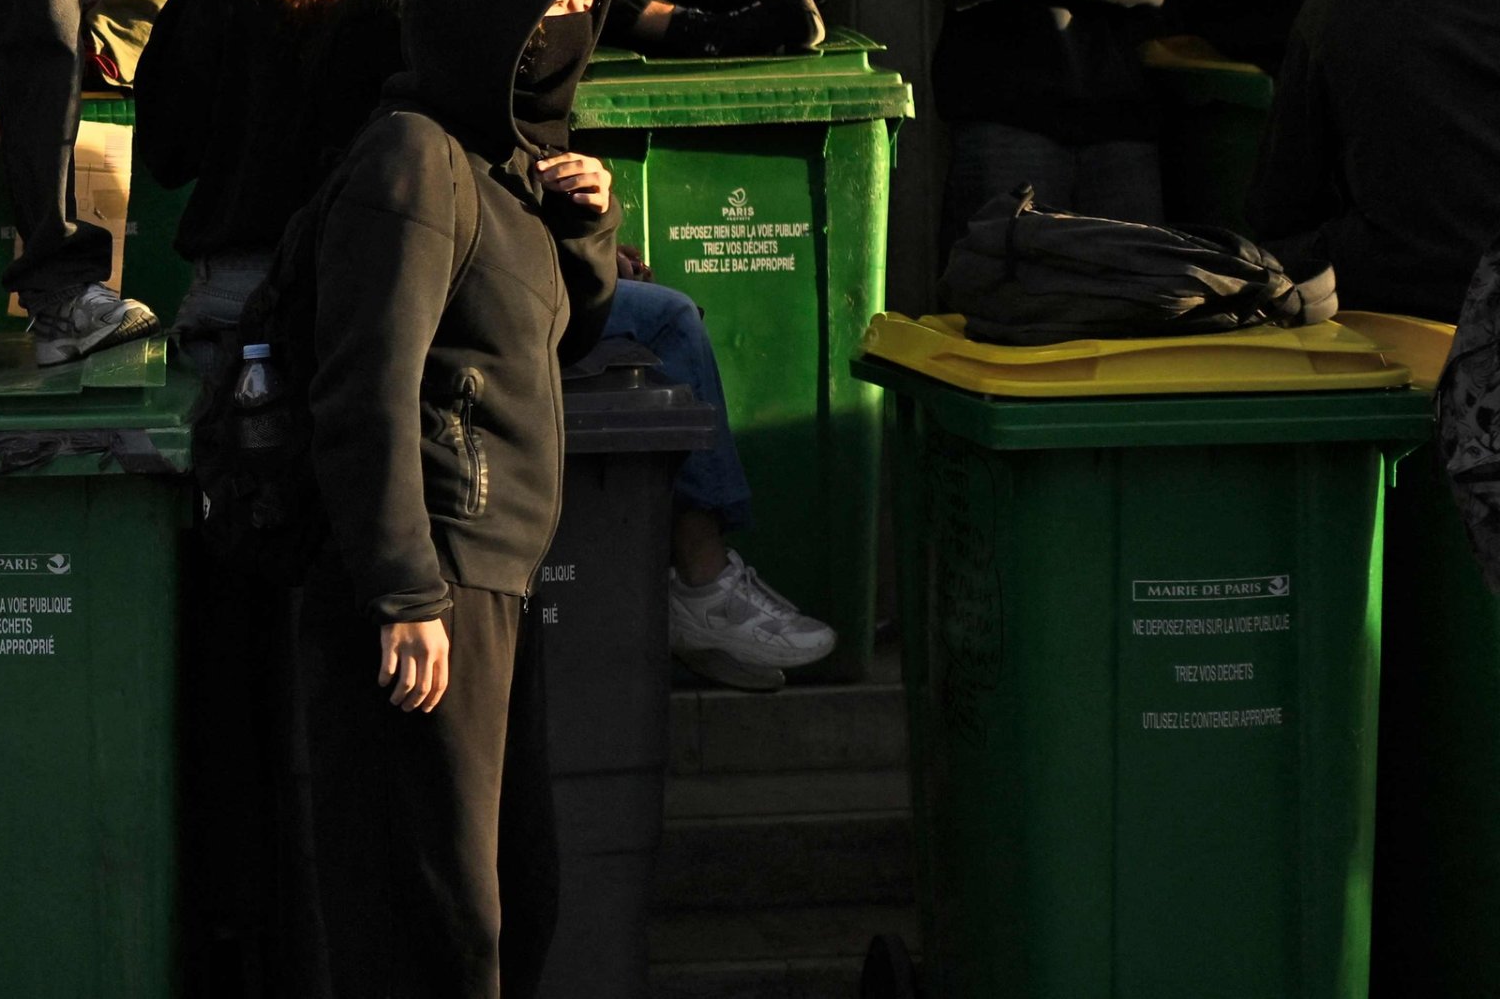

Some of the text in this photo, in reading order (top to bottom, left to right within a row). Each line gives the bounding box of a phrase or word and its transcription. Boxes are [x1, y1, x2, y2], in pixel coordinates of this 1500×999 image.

[721, 206, 755, 217] PARIS
[669, 222, 810, 241] NE DÉPOSEZ RIEN SUR LA VOIE PUBLIQUE
[703, 237, 778, 256] TRIEZ VOS DÉCHETS
[684, 254, 795, 274] UTILISEZ LE BAC APPROPRIÉ
[1147, 582, 1262, 597] MAIRIE DE PARIS
[7, 597, 28, 613] VOIE
[29, 597, 73, 613] PUBLIQUE
[1132, 613, 1290, 636] NE DEPOSEZ RIEN SUR LA VOIE PUBLIQUE
[0, 635, 55, 655] APPROPRIÉ
[1174, 662, 1254, 683] TRIEZ VOS DECHETS
[1142, 707, 1283, 729] UTILISEZ LE CONTENEUR APPROPRIE
